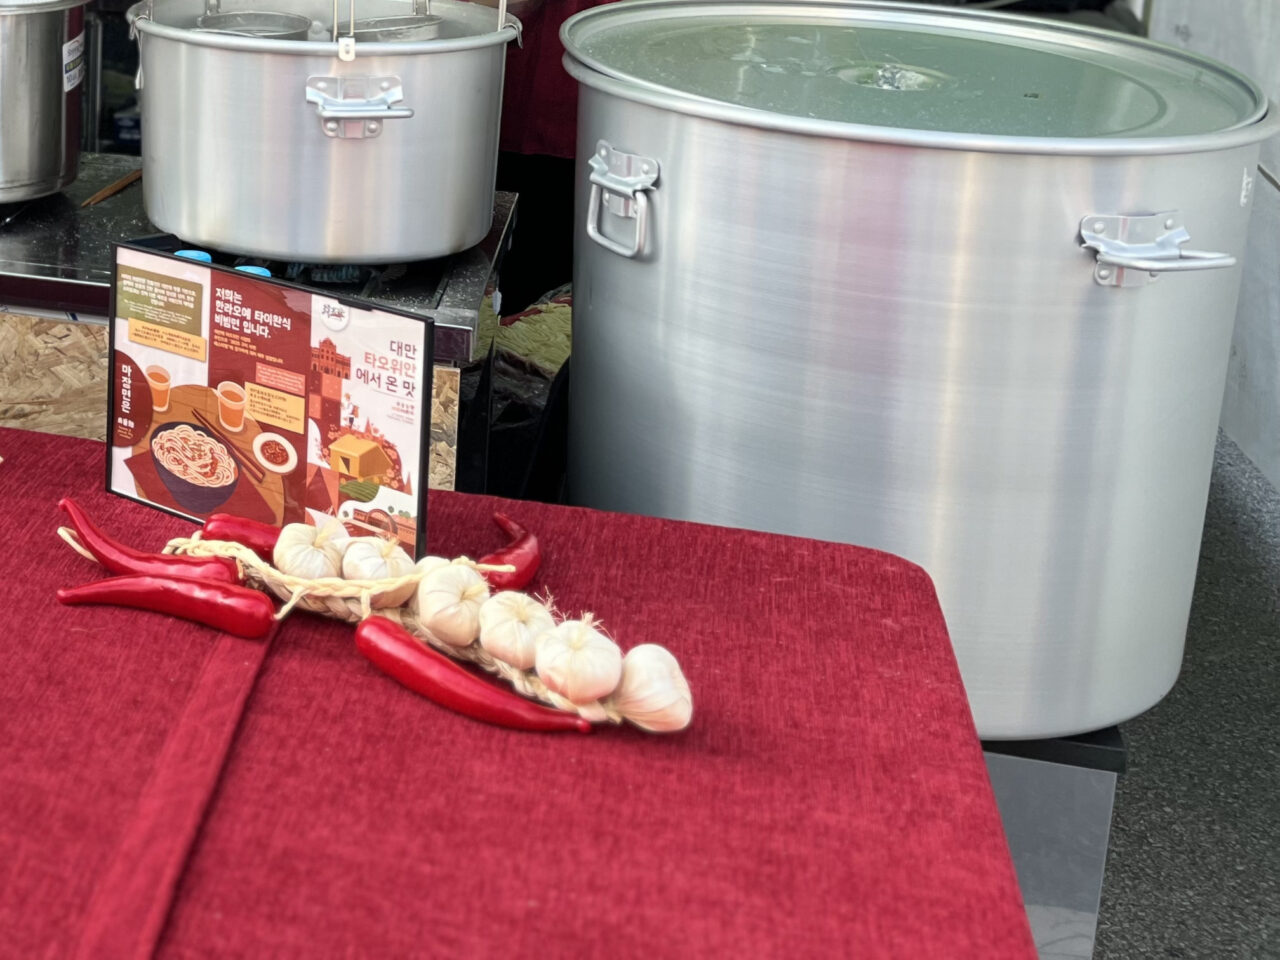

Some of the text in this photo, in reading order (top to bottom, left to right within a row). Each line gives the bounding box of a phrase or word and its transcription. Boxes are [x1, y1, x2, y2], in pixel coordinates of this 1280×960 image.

[215, 287, 243, 305] 저희는
[214, 313, 240, 332] 비빔면
[254, 310, 291, 331] 타이완식
[389, 340, 417, 361] 대만
[363, 351, 417, 379] 타오위안
[355, 367, 416, 398] 에서 온 맛
